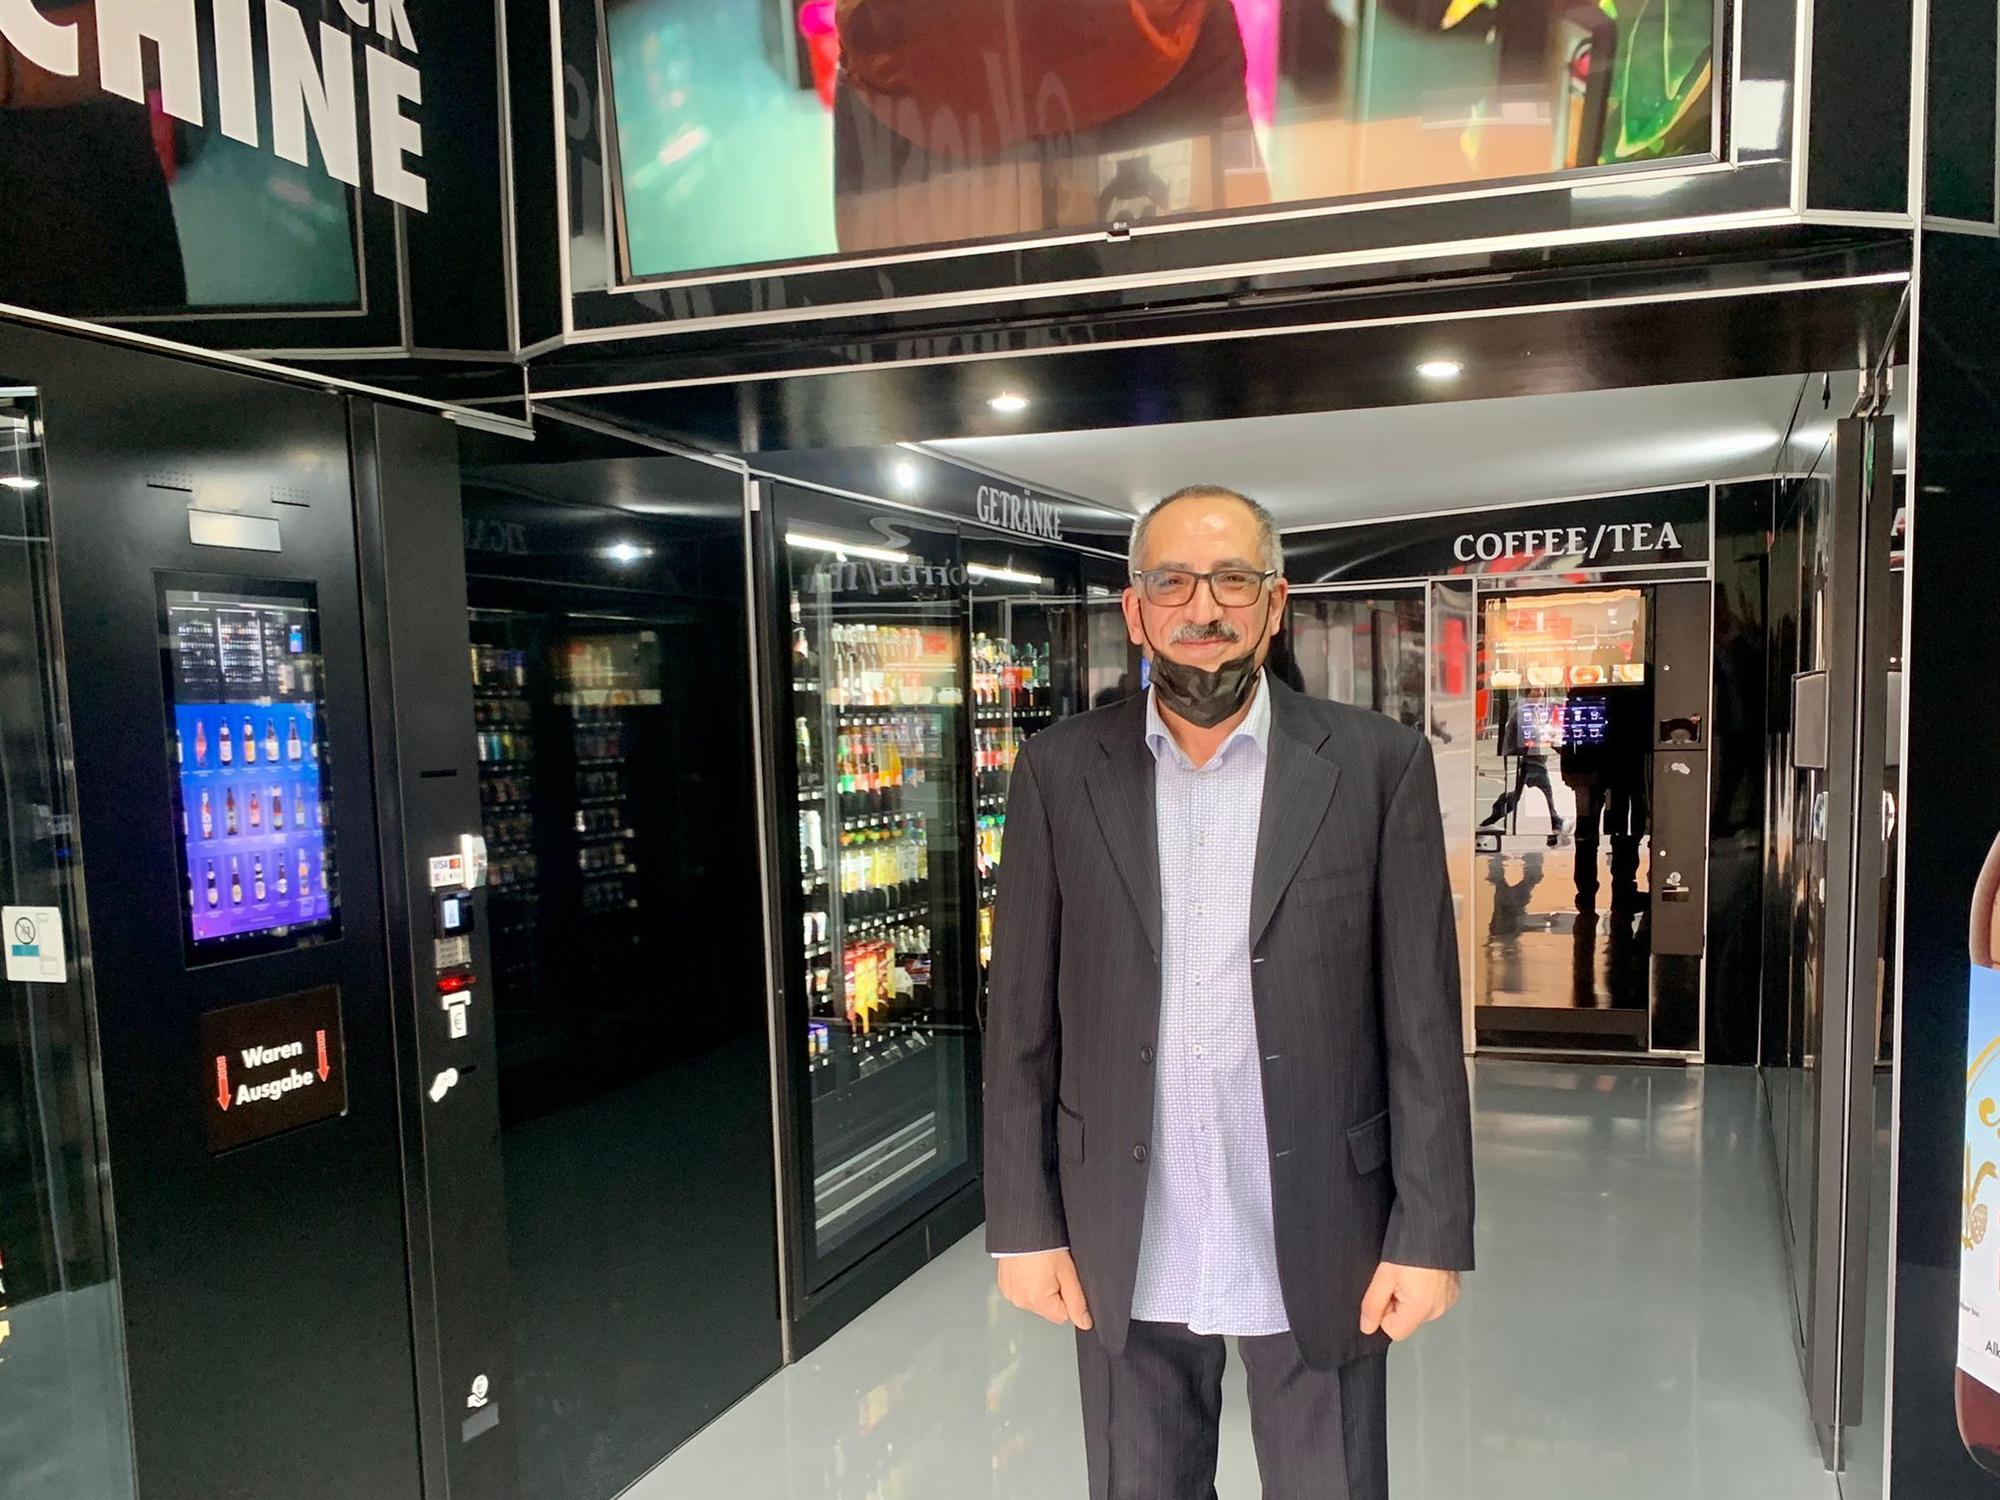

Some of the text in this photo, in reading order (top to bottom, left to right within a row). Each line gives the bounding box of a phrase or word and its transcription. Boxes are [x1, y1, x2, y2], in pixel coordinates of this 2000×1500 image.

[977, 485, 1063, 540] GETRÄNKE
[1453, 522, 1682, 562] COFFEE/TEA
[241, 1041, 303, 1068] Waren
[235, 1068, 314, 1106] Ausgabe
